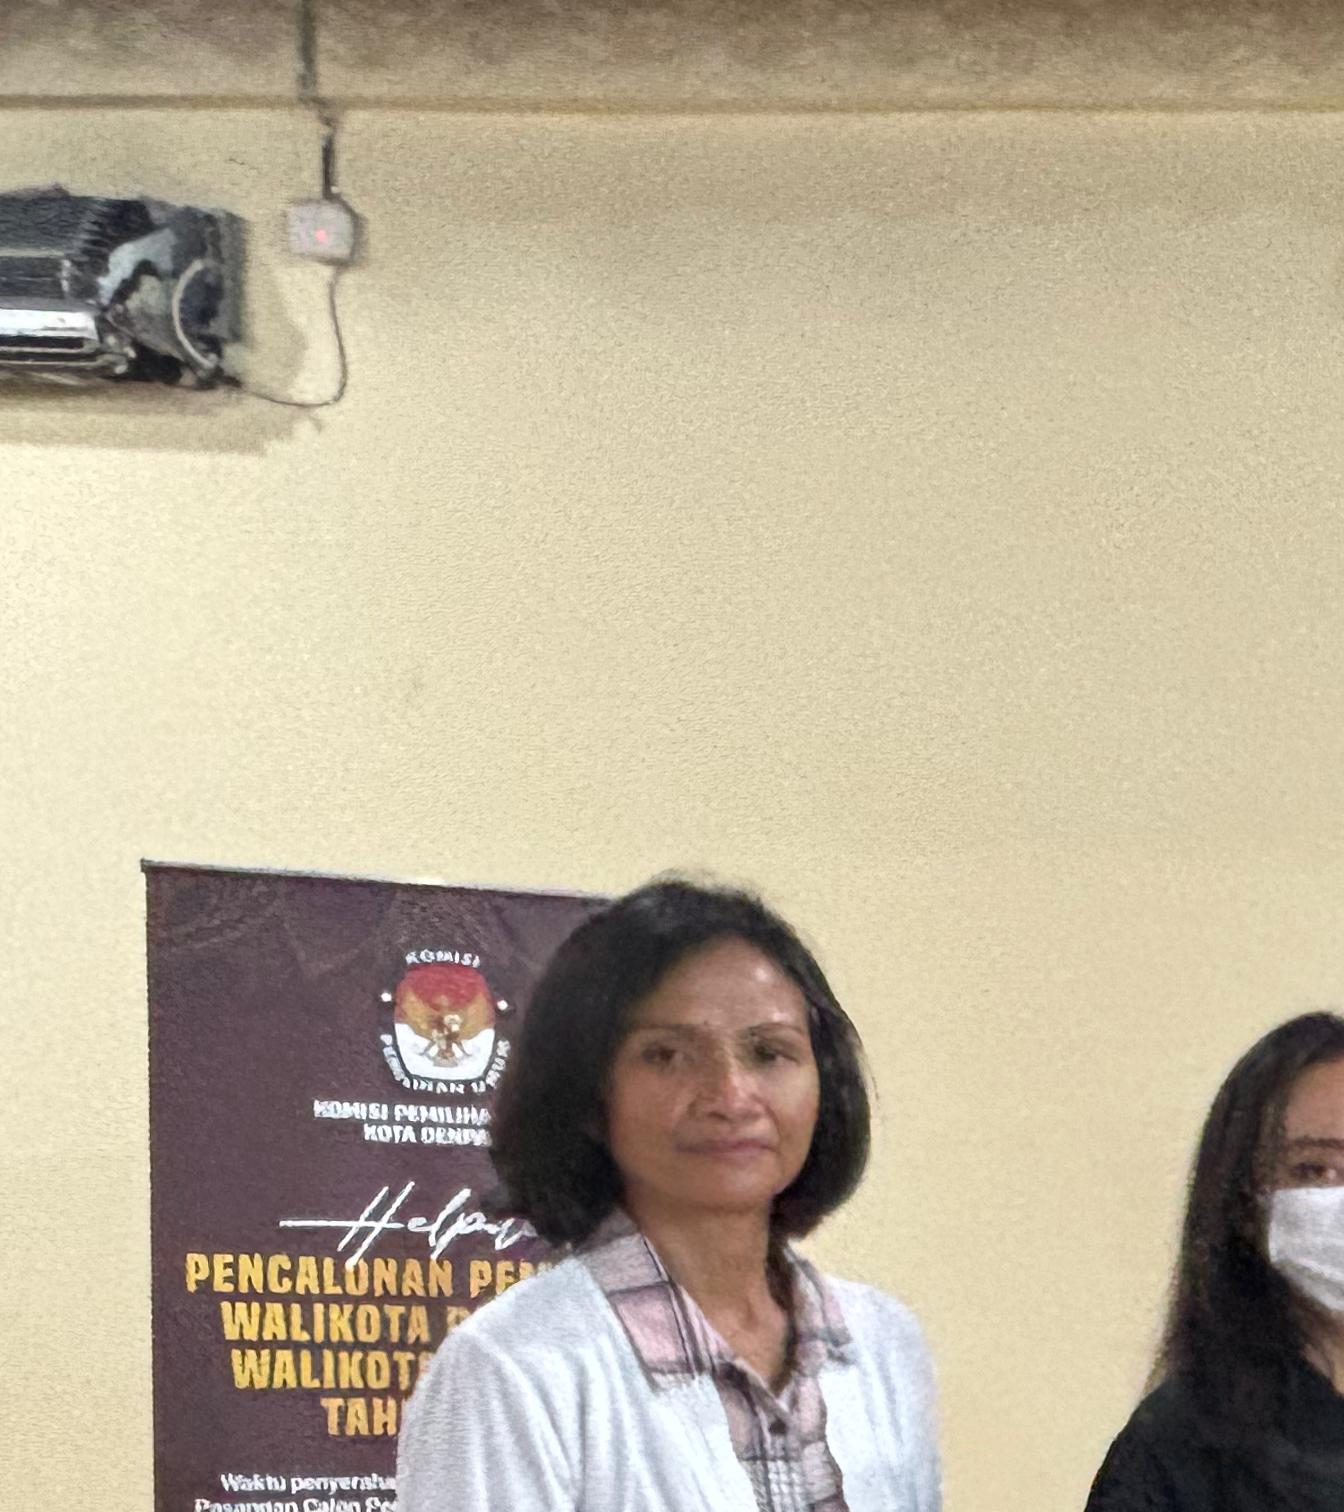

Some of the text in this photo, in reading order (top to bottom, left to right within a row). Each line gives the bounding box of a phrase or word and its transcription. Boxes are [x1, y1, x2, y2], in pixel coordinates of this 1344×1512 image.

[404, 949, 482, 968] KOMISI
[313, 1100, 388, 1121] KOMISI
[363, 1123, 417, 1144] KOTA
[185, 1253, 453, 1297] PENCALONAN
[220, 1301, 432, 1345] WALIKOTA
[220, 1473, 287, 1492] Waktu
